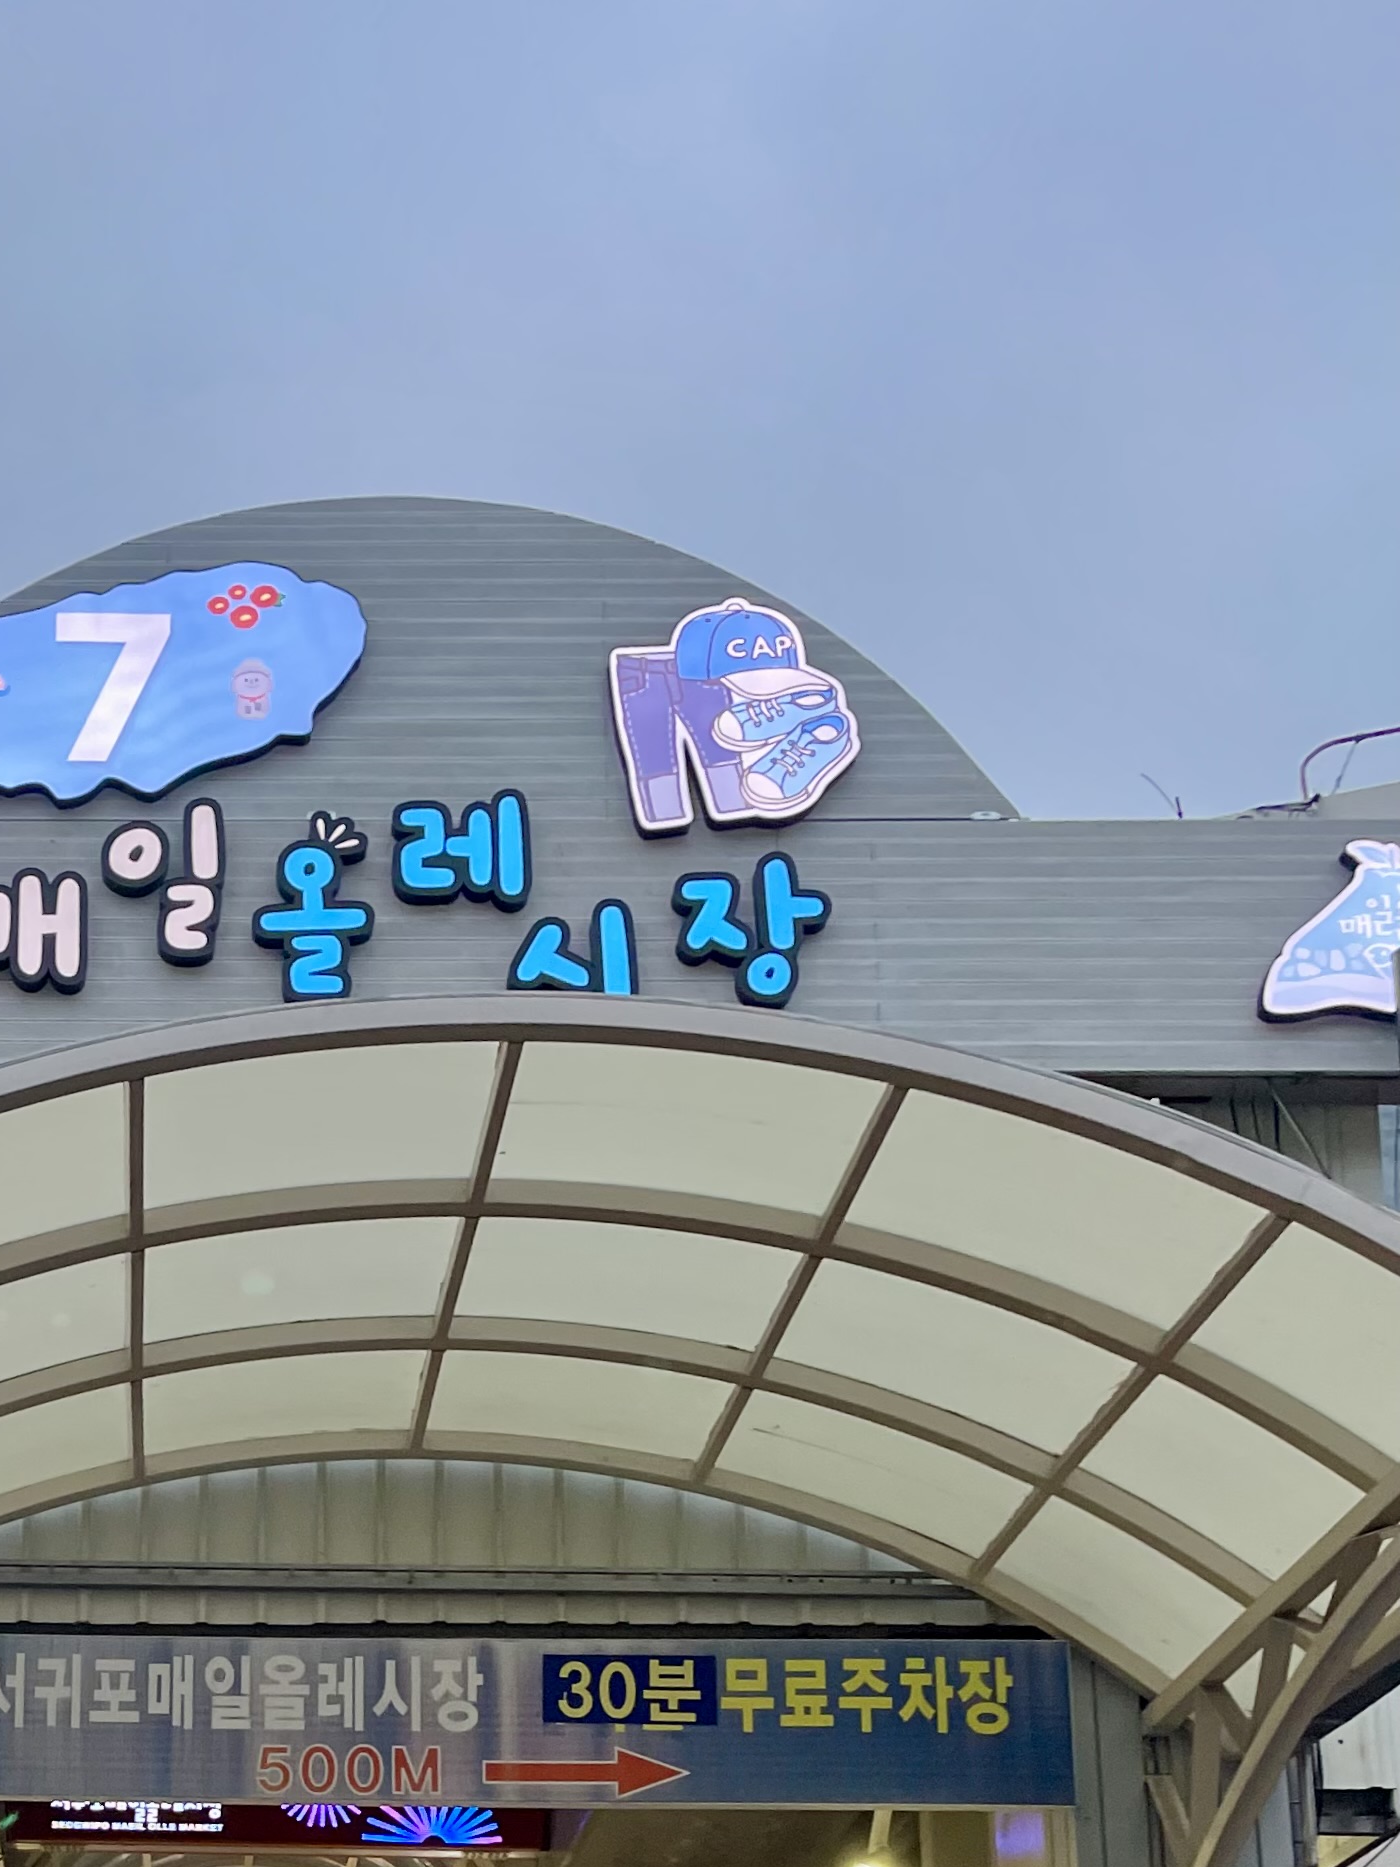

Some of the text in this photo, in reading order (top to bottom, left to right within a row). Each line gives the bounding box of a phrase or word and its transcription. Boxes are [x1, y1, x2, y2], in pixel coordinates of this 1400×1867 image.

[726, 635, 792, 659] CAP
[55, 612, 171, 763] 7
[558, 1659, 701, 1723] 30분
[720, 1656, 1014, 1735] 무료주차장
[257, 1744, 440, 1795] 500M
